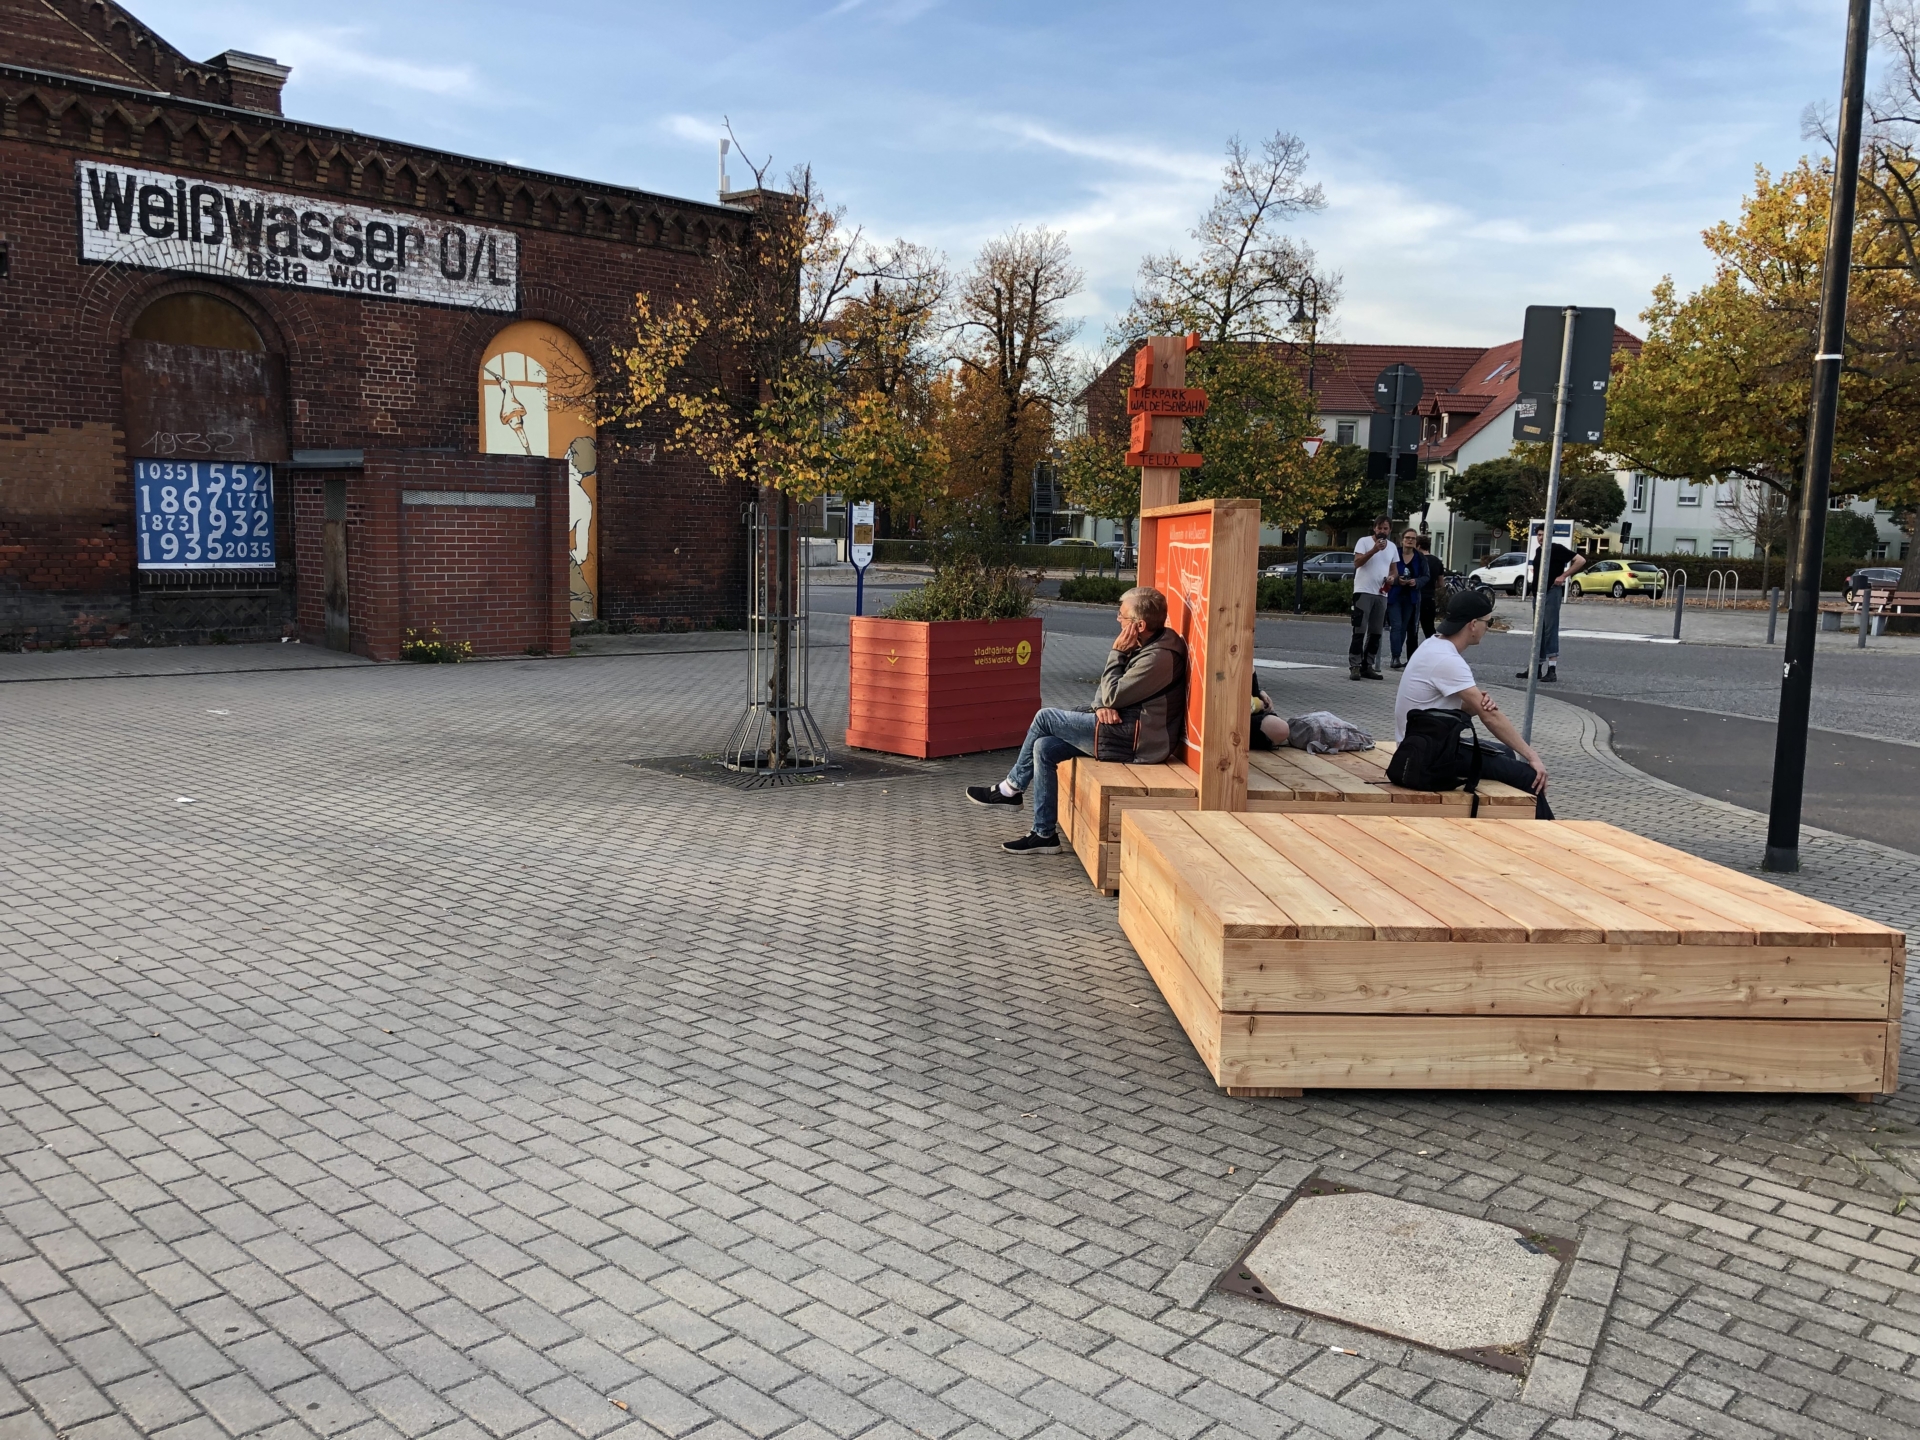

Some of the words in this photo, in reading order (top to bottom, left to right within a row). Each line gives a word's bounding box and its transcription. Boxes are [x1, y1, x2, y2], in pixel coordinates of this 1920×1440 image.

[86, 167, 425, 272] Weißwasser
[327, 263, 397, 294] Woda
[1133, 389, 1187, 401] TIERPARK
[1139, 453, 1180, 466] TELUX
[138, 462, 188, 480] 1035
[189, 463, 268, 492] 1552
[140, 484, 223, 514] 1867
[225, 492, 269, 509] 1771
[140, 514, 190, 532] 1873
[191, 510, 269, 537] 1932
[140, 532, 224, 560] 1935
[225, 541, 272, 558] 2035
[974, 645, 1015, 656] stadtgärtner
[974, 656, 1014, 665] weisswasser
